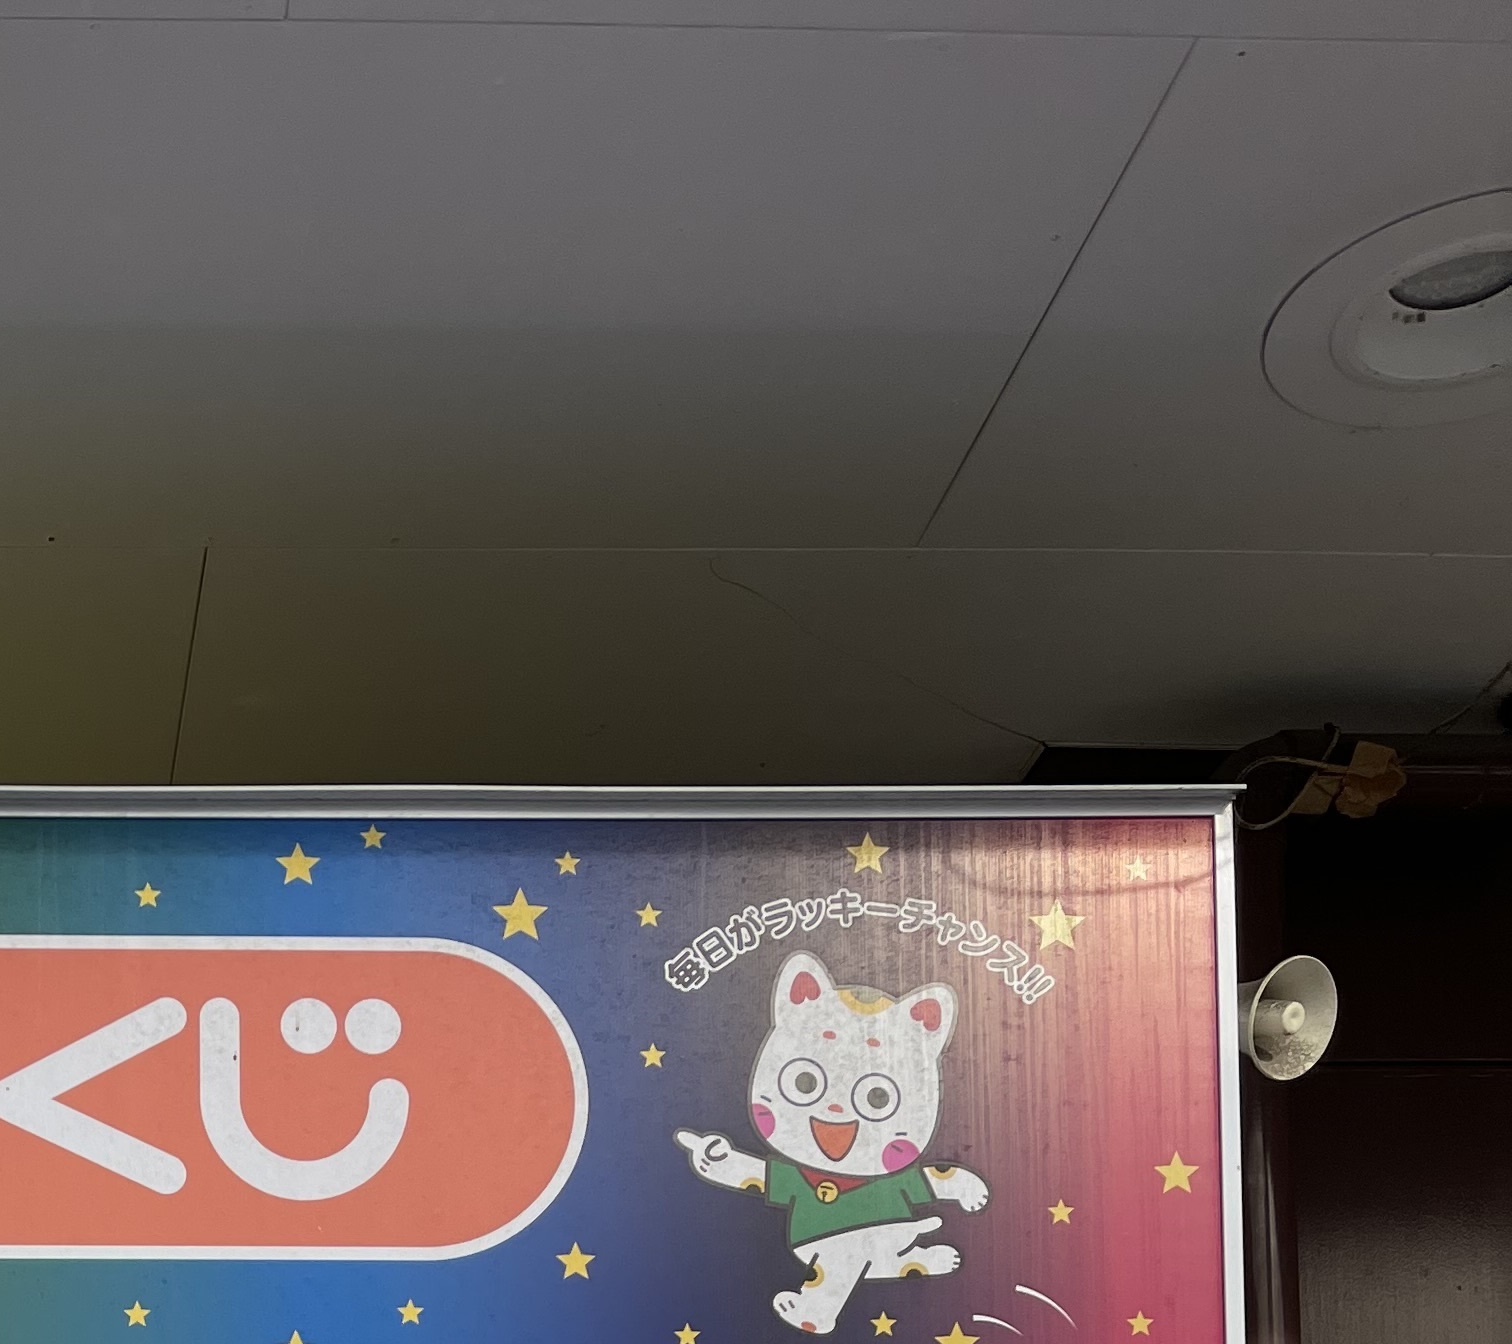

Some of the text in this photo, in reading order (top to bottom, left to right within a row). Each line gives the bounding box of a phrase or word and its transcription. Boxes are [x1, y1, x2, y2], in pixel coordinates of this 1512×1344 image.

[666, 888, 1055, 1005] 毎日がラッキーチャンス!!
